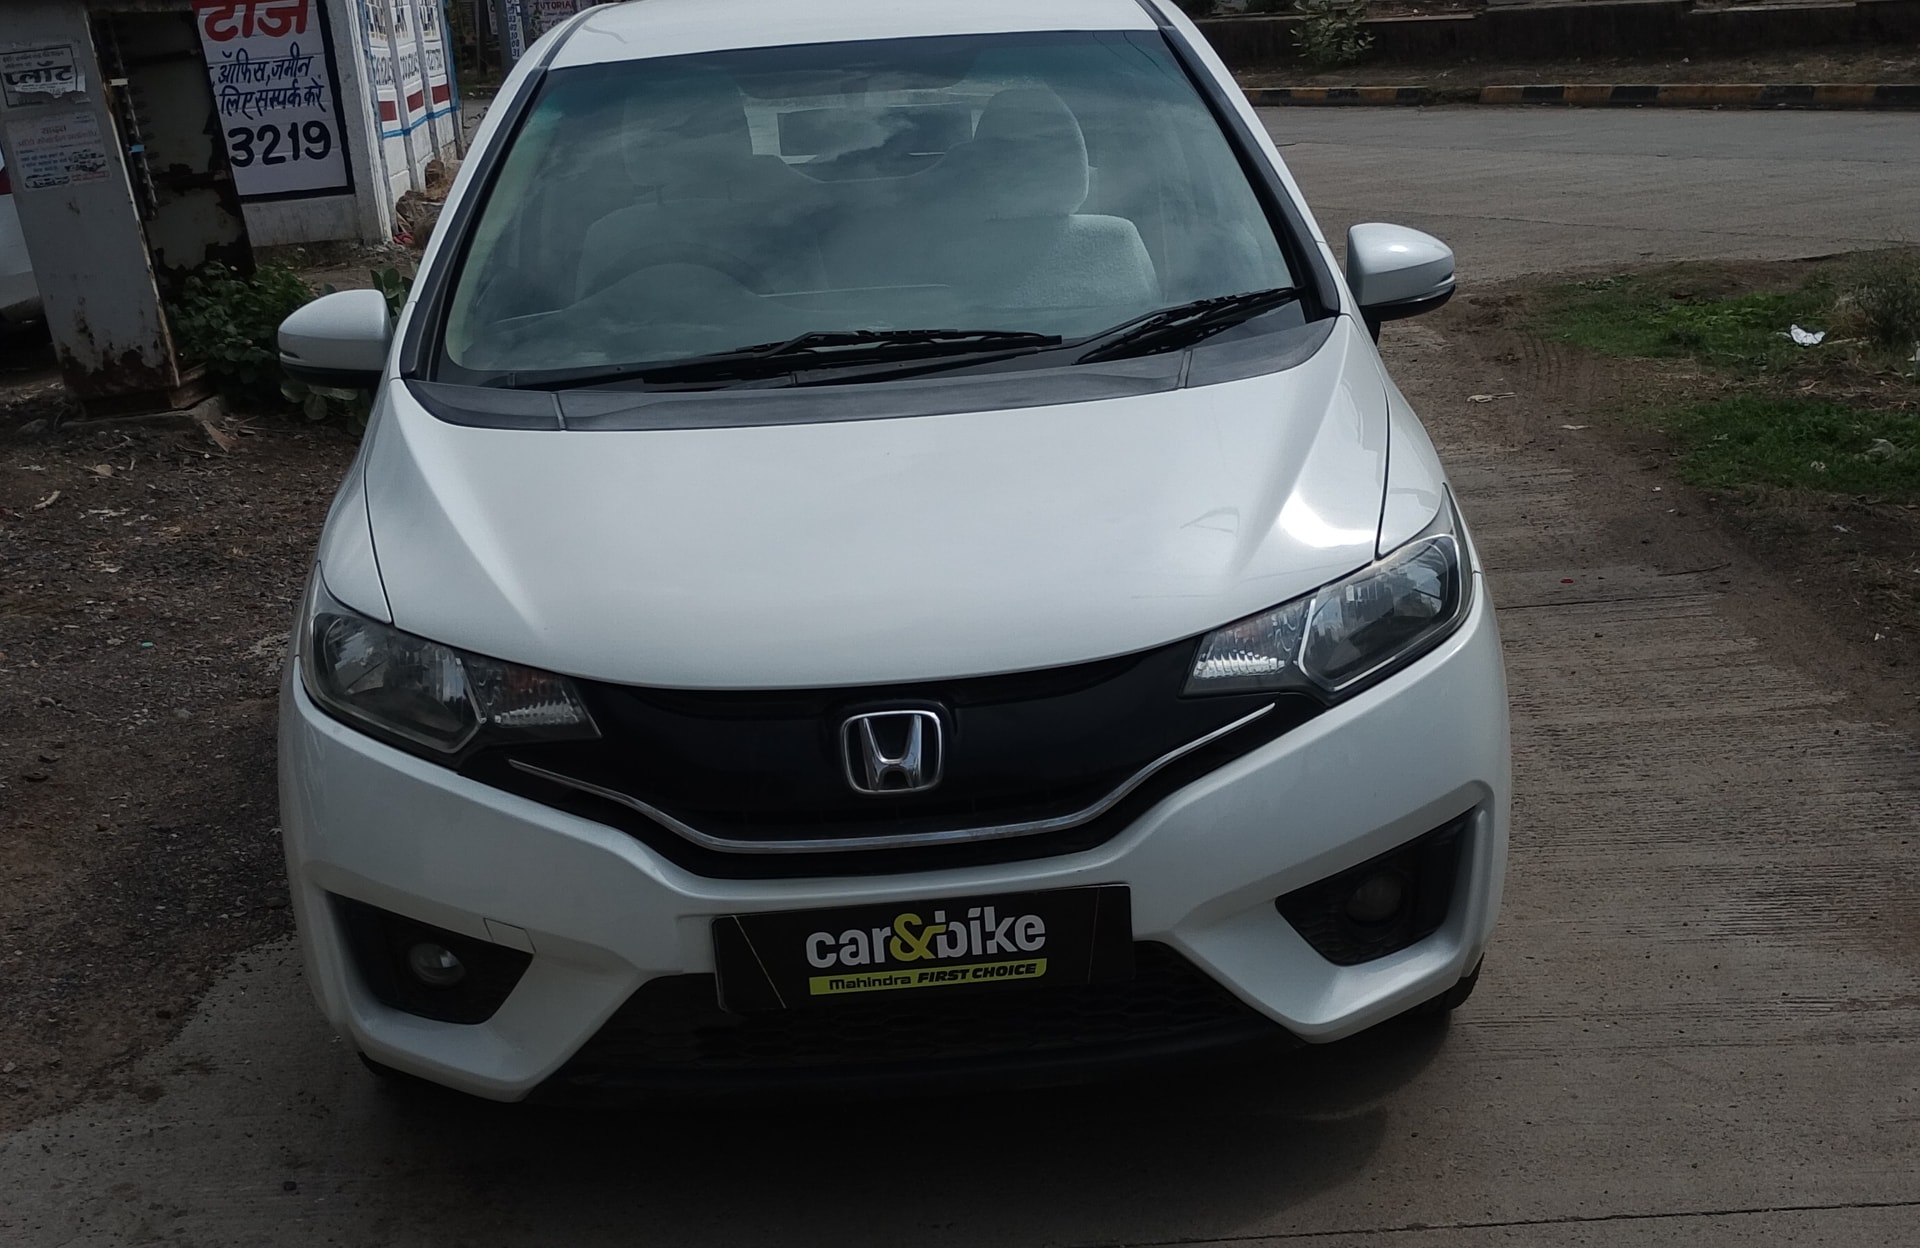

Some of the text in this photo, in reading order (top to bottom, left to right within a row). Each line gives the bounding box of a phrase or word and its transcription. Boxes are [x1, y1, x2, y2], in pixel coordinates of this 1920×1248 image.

[3, 60, 73, 85] प्लॉट
[228, 120, 331, 168] 3219
[806, 906, 1046, 968] car&bike
[829, 963, 1037, 990] Mahindra FIRST CHOICE
